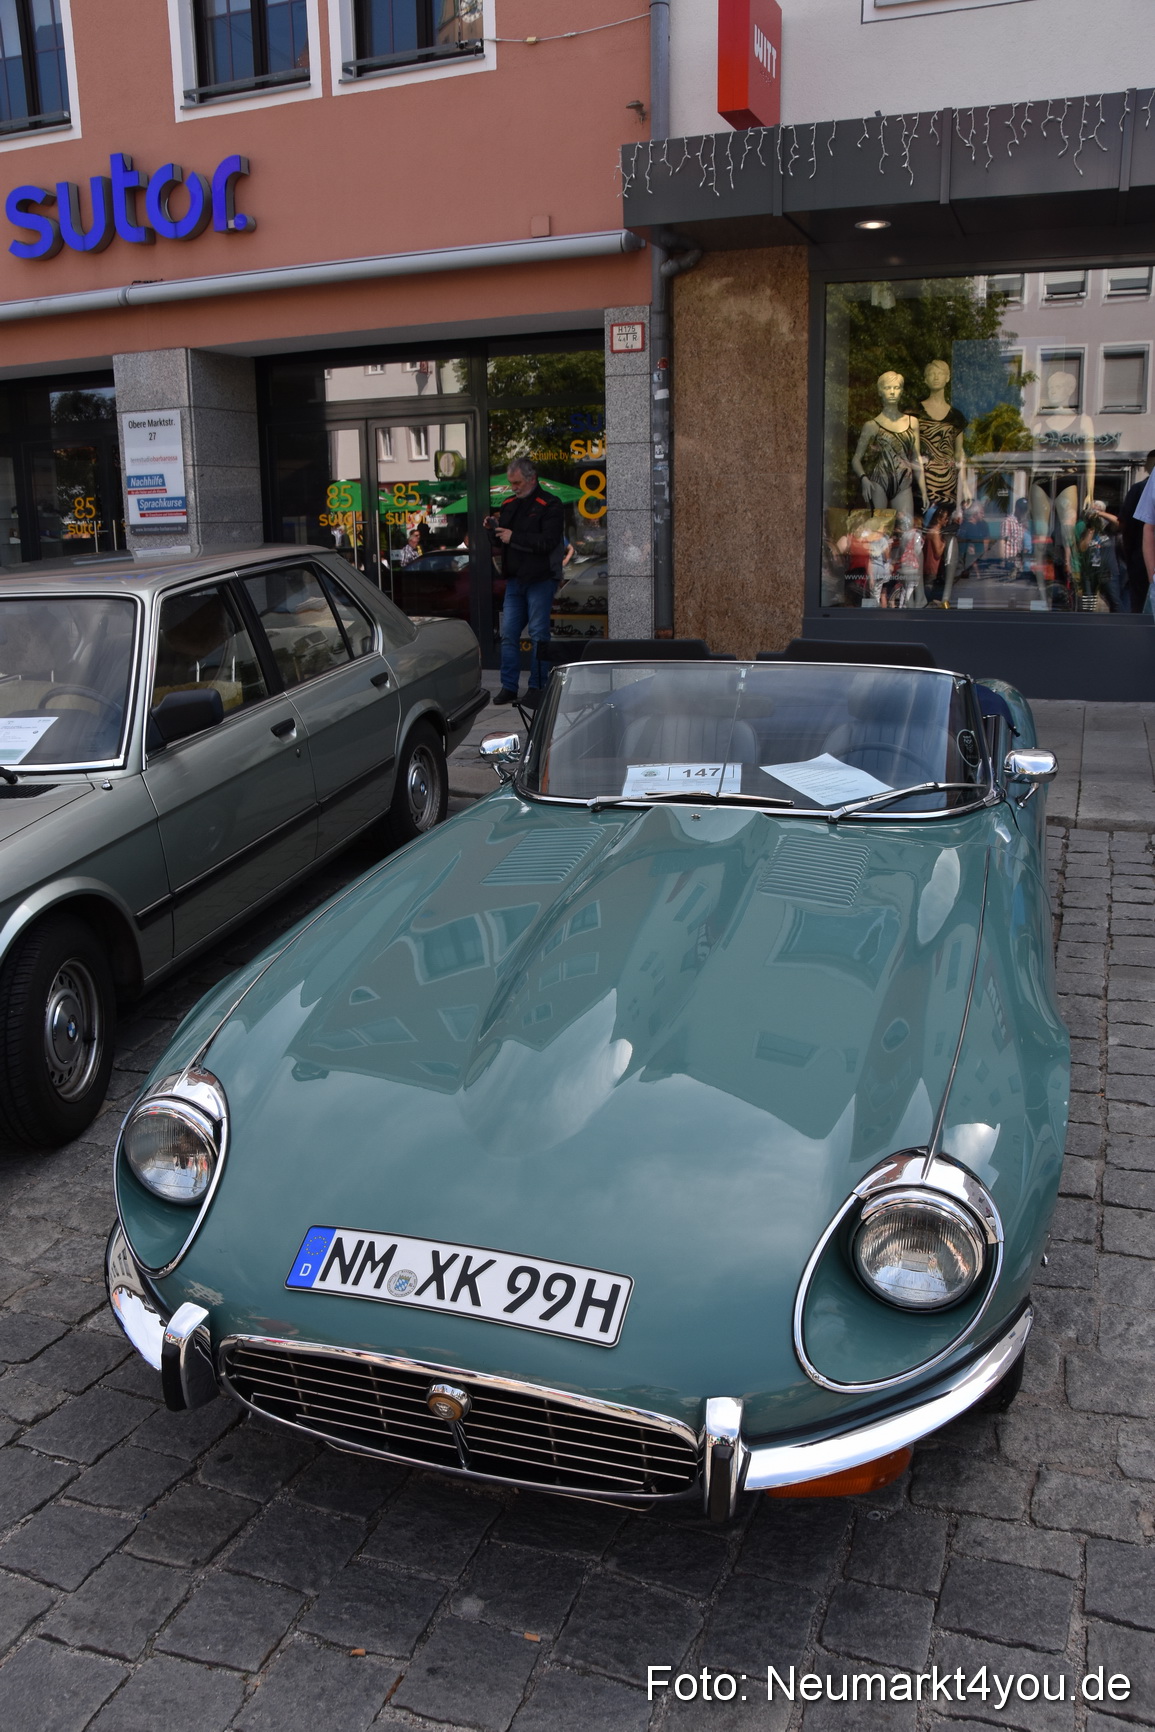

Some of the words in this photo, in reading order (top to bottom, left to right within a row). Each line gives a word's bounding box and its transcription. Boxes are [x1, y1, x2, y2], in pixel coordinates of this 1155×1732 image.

[754, 24, 777, 79] WITT
[618, 325, 636, 333] H175
[128, 420, 146, 429] Obere
[147, 418, 176, 427] Marktstr.
[148, 432, 157, 441] 27
[559, 449, 569, 462] by
[130, 475, 163, 487] Nachhilfe
[326, 485, 352, 509] 85
[393, 482, 420, 507] 85
[74, 497, 96, 519] 85
[139, 498, 182, 510] Sprachkurse
[682, 767, 721, 778] 147
[299, 1262, 312, 1277] D
[318, 1237, 398, 1290] NM
[414, 1249, 497, 1307] XK
[502, 1265, 622, 1333] 99H
